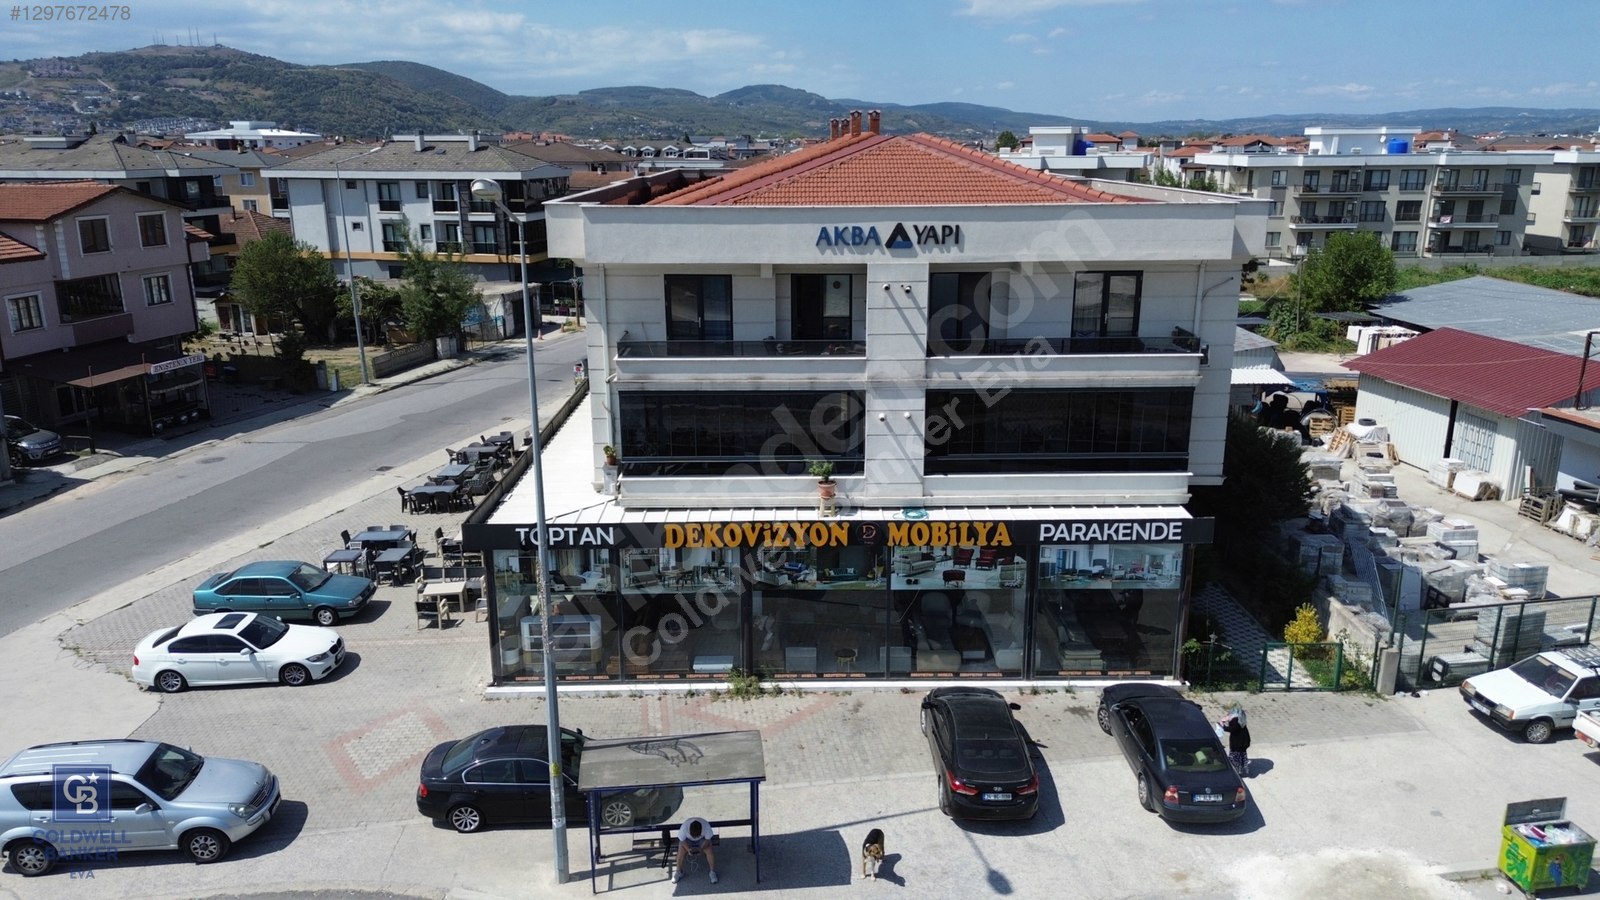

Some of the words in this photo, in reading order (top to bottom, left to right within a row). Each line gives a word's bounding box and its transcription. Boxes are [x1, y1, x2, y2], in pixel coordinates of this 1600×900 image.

[816, 226, 881, 247] AKBA
[913, 225, 960, 245] YAPI
[516, 526, 614, 546] TOPTAN
[1039, 522, 1183, 542] PARAKENDE
